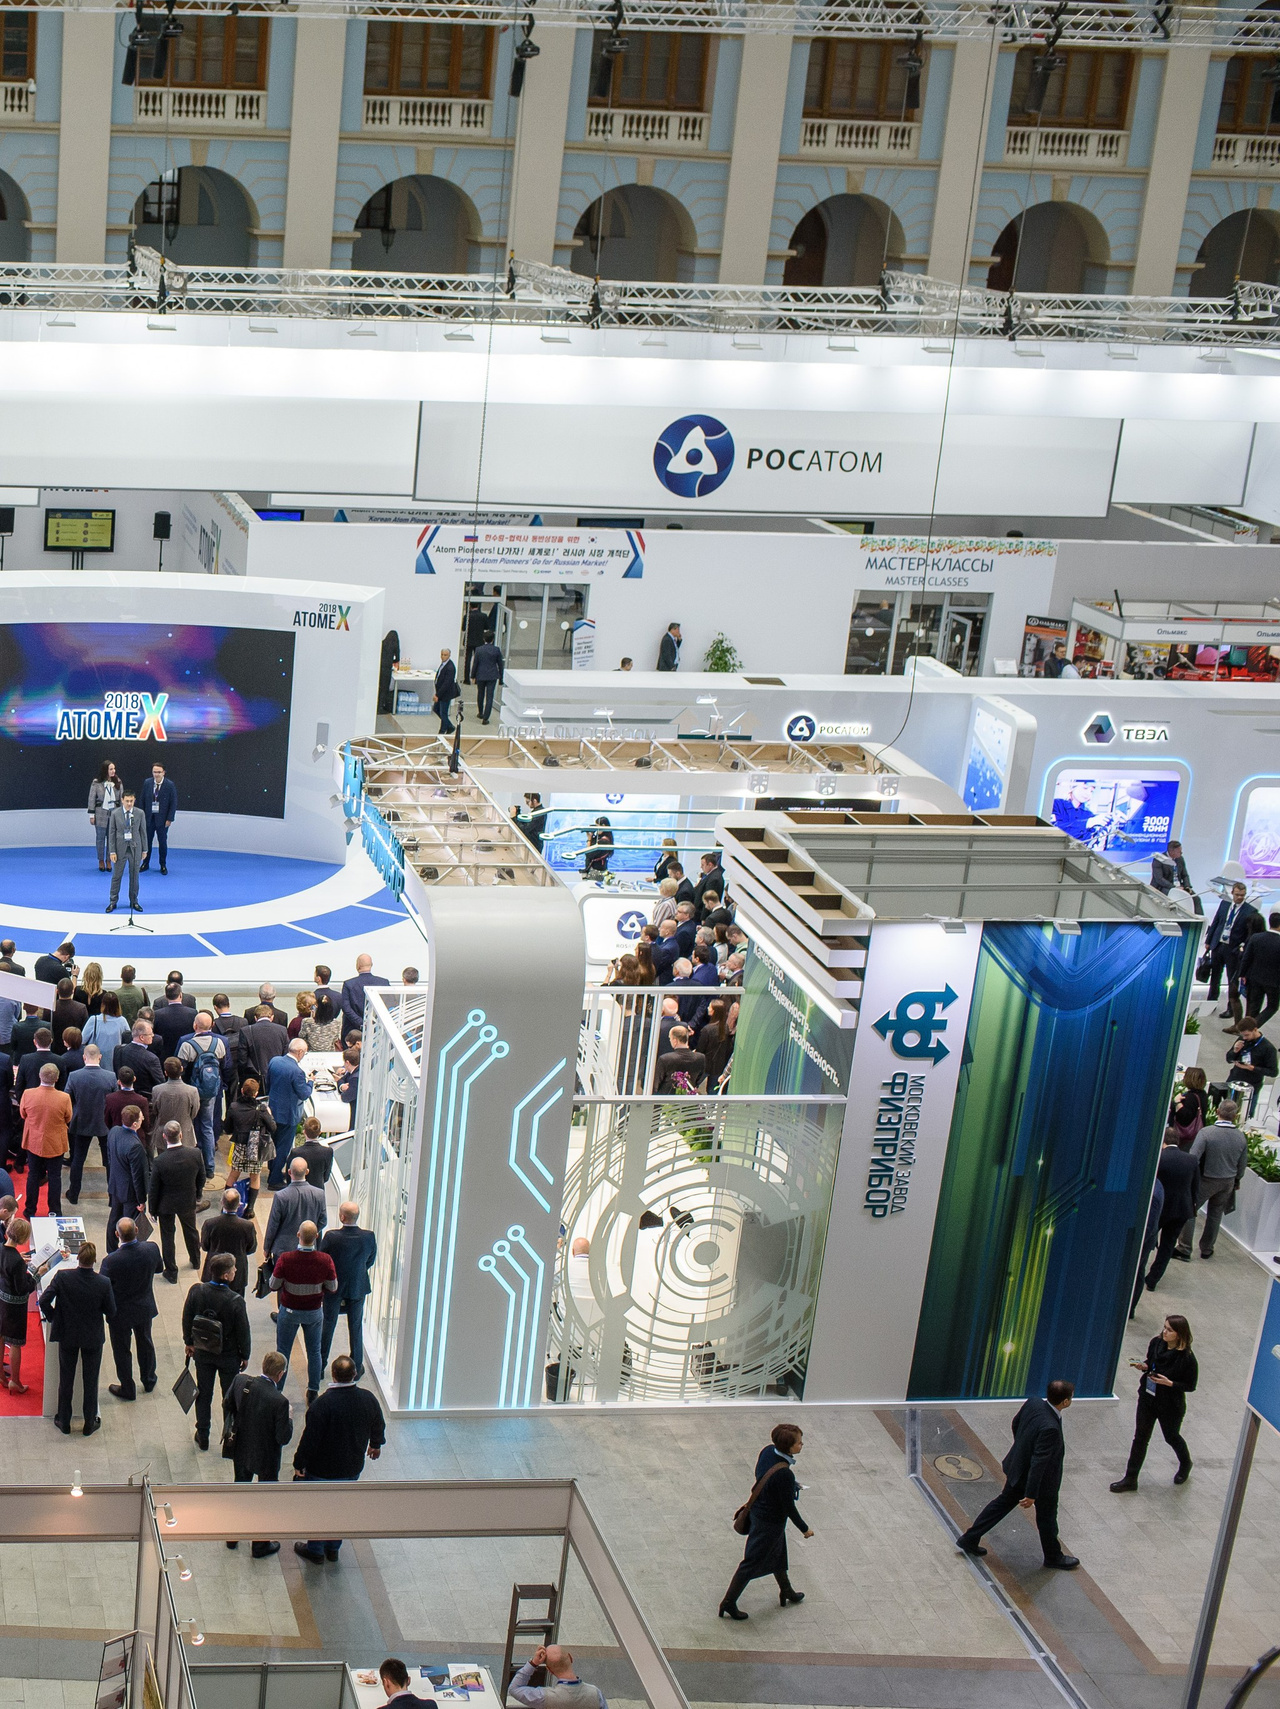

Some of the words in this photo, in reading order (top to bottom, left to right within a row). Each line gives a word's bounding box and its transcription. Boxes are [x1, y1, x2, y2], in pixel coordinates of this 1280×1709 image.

[747, 448, 882, 473] РОСАТОМ
[553, 558, 580, 566] Russian
[865, 556, 994, 572] МАСТЕР-КЛАССЫ
[885, 576, 925, 586] MASTER
[928, 577, 969, 587] CLASSES
[293, 605, 351, 631] ATOMEX
[319, 603, 337, 613] 2018
[105, 693, 139, 709] 2018
[57, 693, 168, 740] ATOMEX
[820, 726, 869, 735] РОСАТОМ
[1144, 816, 1170, 826] 3000
[768, 977, 811, 1033] Надежность.
[789, 1021, 841, 1088] Безопасность.
[897, 1074, 926, 1166] МОСКОВСКИЙ
[863, 1070, 909, 1219] ФИЗПРИБОР
[890, 1170, 911, 1214] ЗАВОД
